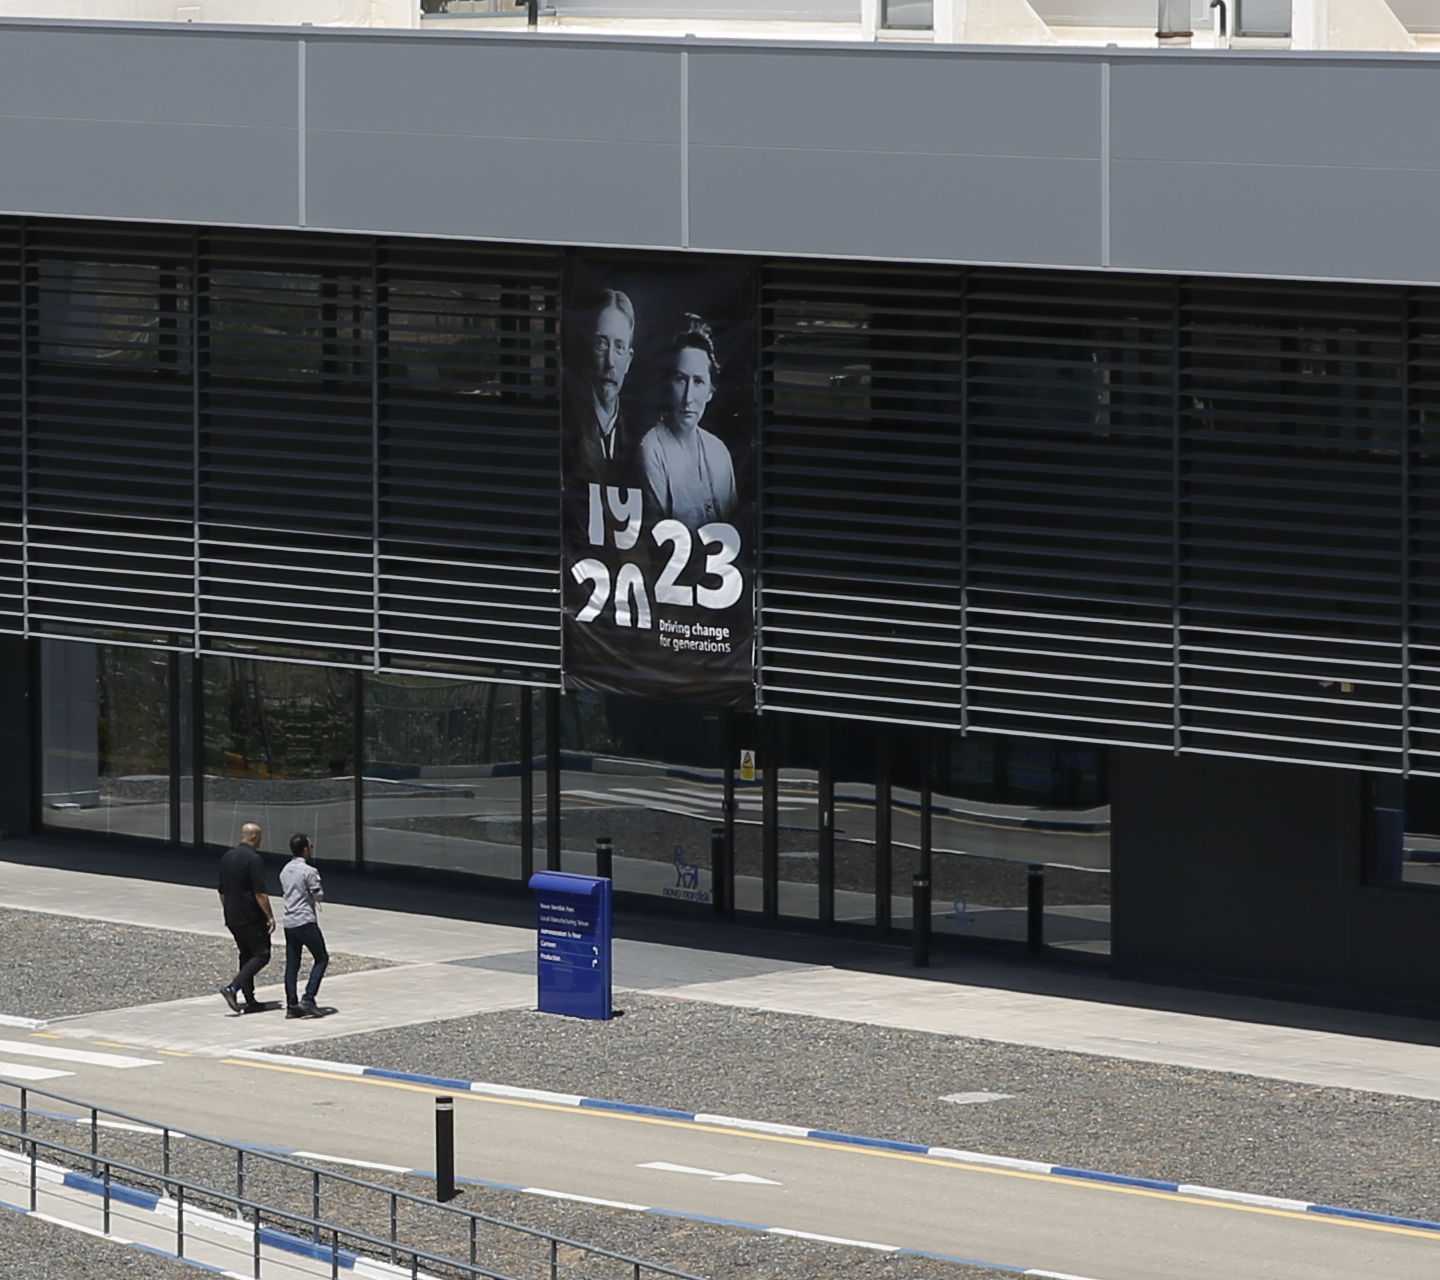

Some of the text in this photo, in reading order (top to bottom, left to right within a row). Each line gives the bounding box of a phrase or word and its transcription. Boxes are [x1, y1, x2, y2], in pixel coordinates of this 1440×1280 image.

[587, 482, 644, 551] 19
[650, 519, 744, 610] 23
[659, 619, 730, 641] Driving change
[659, 634, 732, 653] for generations
